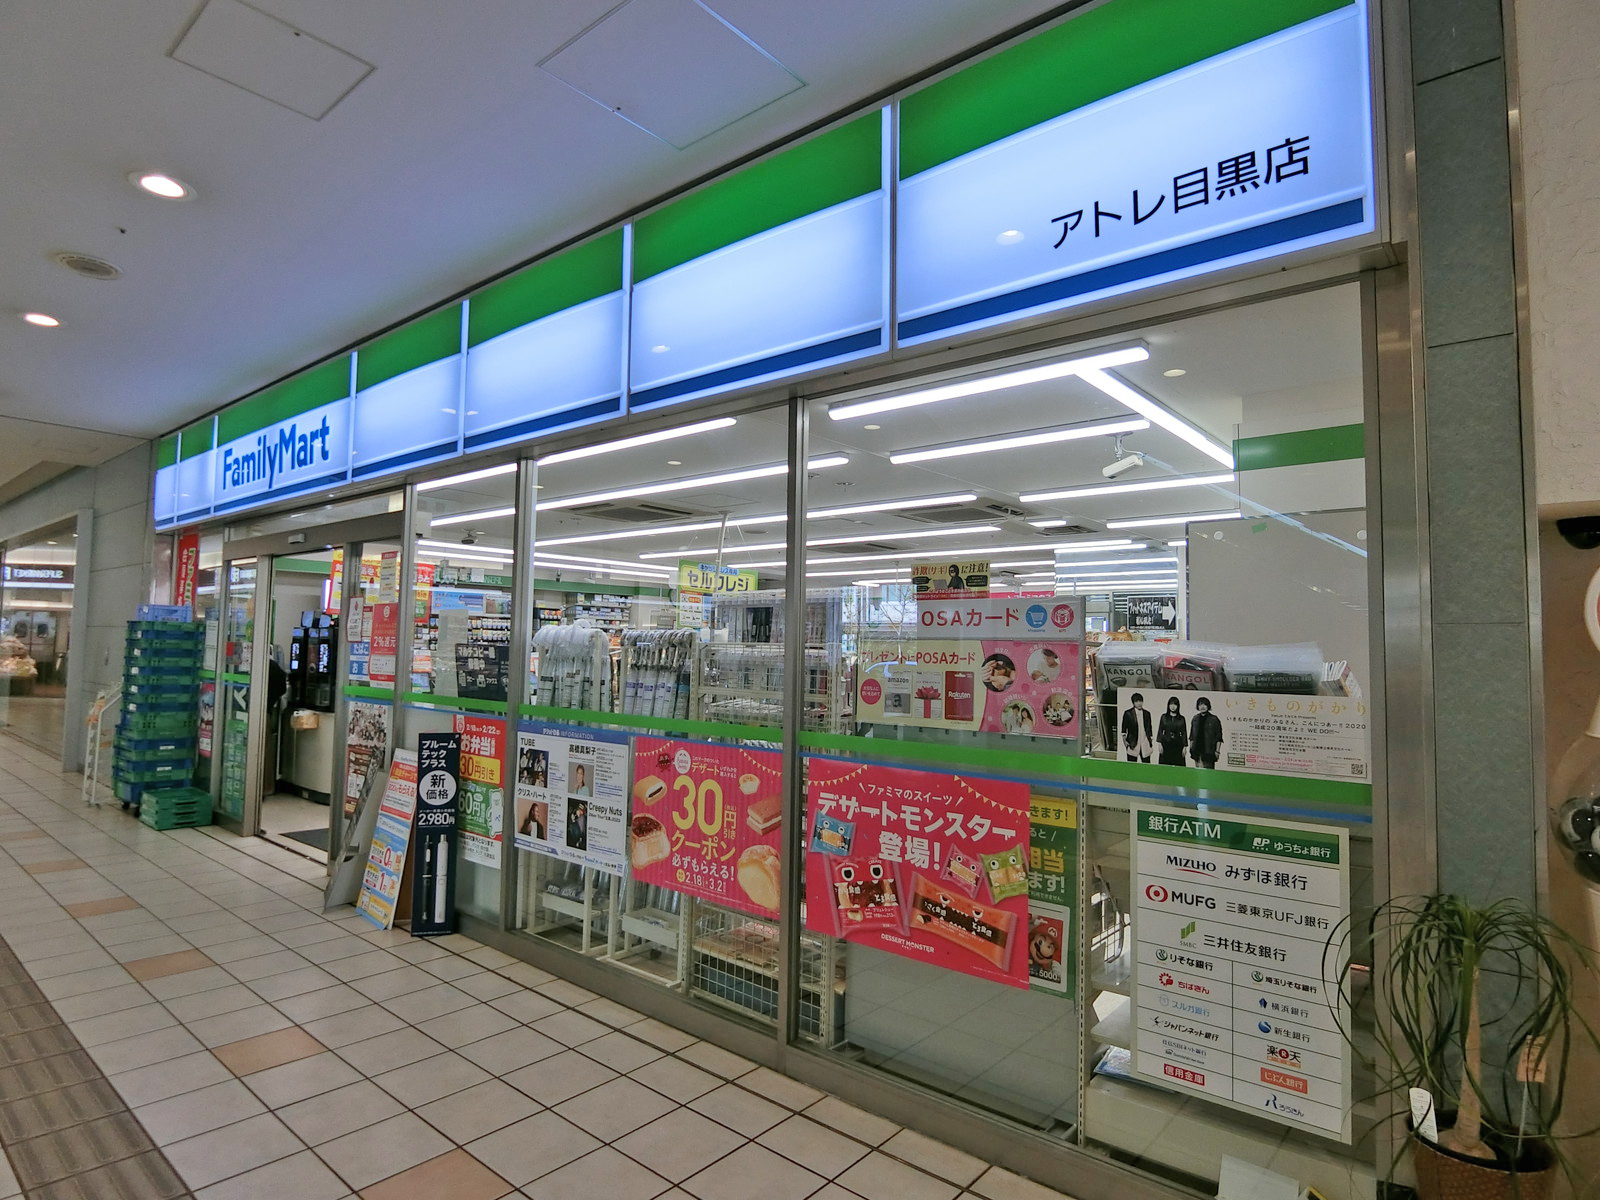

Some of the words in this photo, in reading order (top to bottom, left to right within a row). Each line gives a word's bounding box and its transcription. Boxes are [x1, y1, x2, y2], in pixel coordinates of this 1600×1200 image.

[1051, 135, 1310, 249] アトレ目黒店
[223, 415, 330, 490] FamilyMart
[701, 564, 738, 575] キャッシレス専用
[354, 643, 369, 655] たばこ
[1107, 667, 1150, 677] KANGOL
[1164, 671, 1210, 685] KANGOL
[948, 691, 971, 700] Rakuten
[1225, 697, 1366, 716] いきものがかり
[520, 738, 536, 747] TUBE
[560, 730, 594, 740] INFORMATION
[461, 734, 491, 756] お弁当
[421, 750, 447, 759] テック
[460, 756, 495, 781] 30円引き
[692, 762, 720, 777] デザート
[430, 774, 446, 788] 新
[426, 789, 448, 800] 価格
[518, 788, 547, 800] クリス・ハート
[868, 784, 952, 807] ファミマのスイーツ
[588, 802, 608, 815] Creepy
[609, 806, 623, 817] Nuts
[672, 775, 723, 836] 30
[1030, 804, 1069, 821] きます!
[418, 813, 455, 825] 2,980円
[818, 791, 1016, 842] デザートモンスター
[1148, 815, 1221, 840] 銀行ATM
[672, 830, 736, 862] クーポン
[878, 831, 941, 871] 登場!
[1273, 841, 1331, 858] ゆうちょ銀行
[672, 853, 734, 881] 必ずもらえる!
[1166, 855, 1216, 872] MIZUHO
[1225, 864, 1308, 891] みずほ銀行
[1171, 890, 1216, 910] MUFG
[1225, 901, 1330, 930] 三菱東京UFJ銀行
[881, 933, 905, 947] DESSERT
[905, 940, 935, 953] MONSTER
[1179, 940, 1197, 949] SMBC
[1203, 934, 1287, 963] 三井住友銀行
[1170, 955, 1213, 972] りそな銀行
[1178, 980, 1210, 995] ちばぎん
[1265, 976, 1317, 994] 埼玉りそな銀行
[1171, 1000, 1210, 1017] スルガ銀行
[1271, 1002, 1309, 1018] 横浜銀行
[1163, 1020, 1219, 1042] ジャパンネット銀行
[1274, 1026, 1310, 1043] 新生銀行
[1164, 1065, 1205, 1085] 信用金庫
[1264, 1071, 1303, 1090] じぶん銀行
[1279, 1104, 1304, 1117] ろうきん
